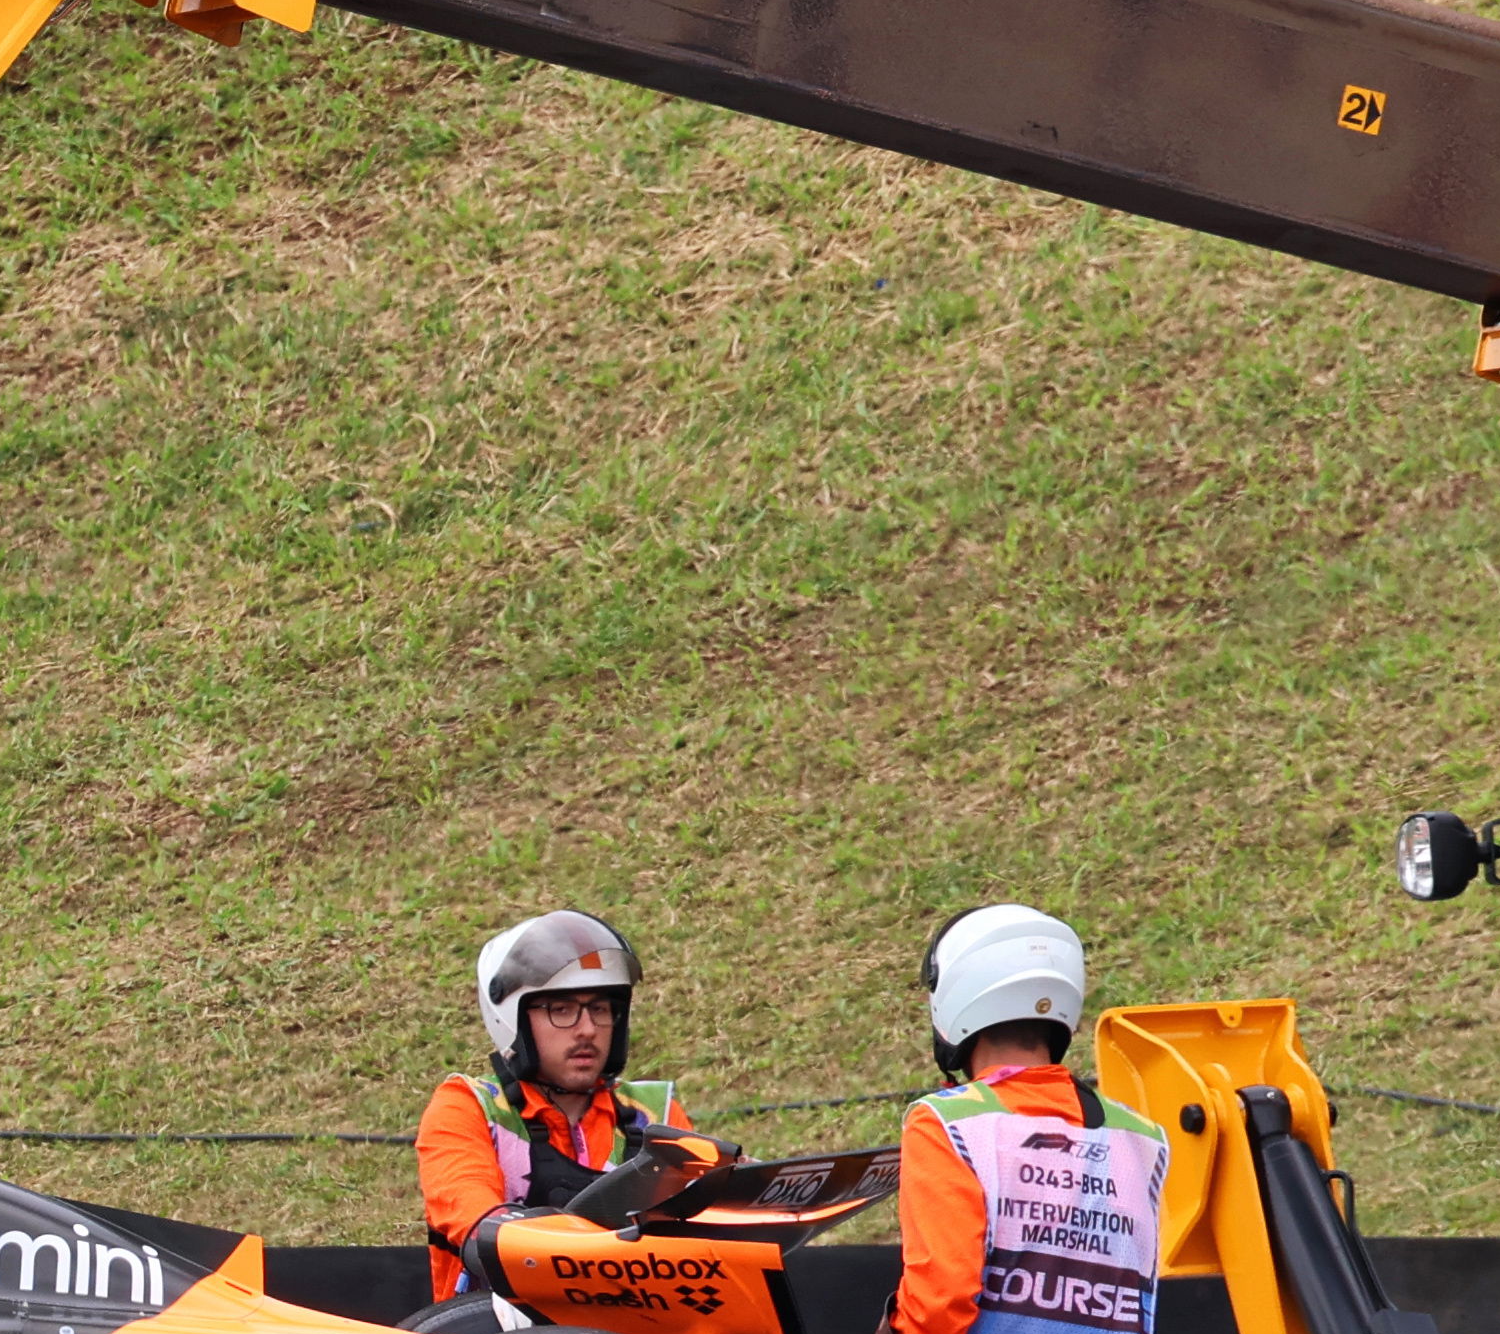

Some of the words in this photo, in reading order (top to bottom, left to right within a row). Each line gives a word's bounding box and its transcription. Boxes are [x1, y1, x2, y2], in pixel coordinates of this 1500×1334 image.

[1342, 93, 1367, 126] 2
[1019, 1164, 1118, 1198] 0243-BRA
[998, 1197, 1134, 1236] INTERVENTION
[1021, 1224, 1112, 1256] MARSHAL
[551, 1253, 728, 1285] Dropbox
[983, 1268, 1140, 1323] COURSE
